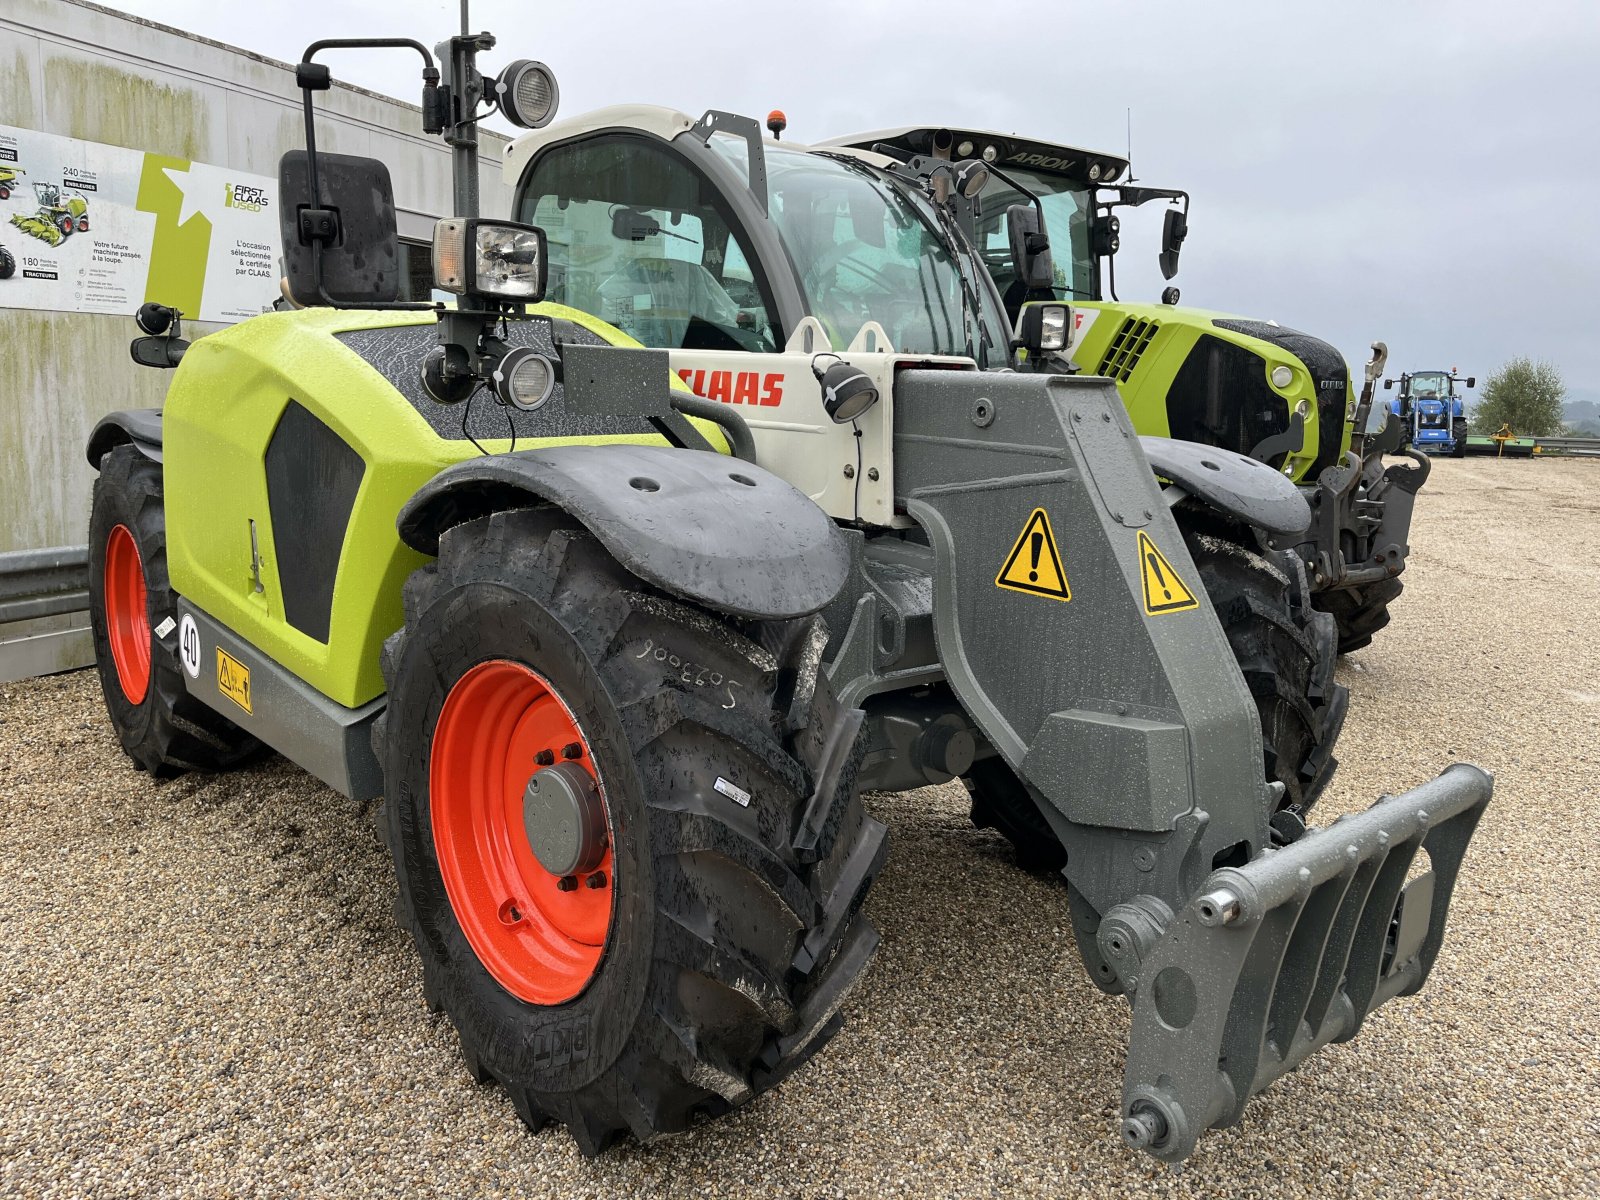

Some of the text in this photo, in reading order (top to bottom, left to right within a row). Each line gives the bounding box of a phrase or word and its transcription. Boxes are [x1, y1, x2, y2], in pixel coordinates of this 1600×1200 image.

[1007, 152, 1076, 170] ARION
[63, 166, 79, 177] 240
[234, 184, 264, 197] FIRST
[234, 193, 269, 206] CLAAS
[233, 201, 261, 212] USED
[93, 240, 129, 251] Votre future
[236, 240, 271, 251] L'occasion
[93, 248, 119, 257] machine
[230, 249, 272, 260] sélectionnée
[22, 257, 39, 267] 180
[239, 258, 272, 269] & certifiée
[25, 271, 56, 279] TRACTEURS
[184, 624, 197, 667] 40
